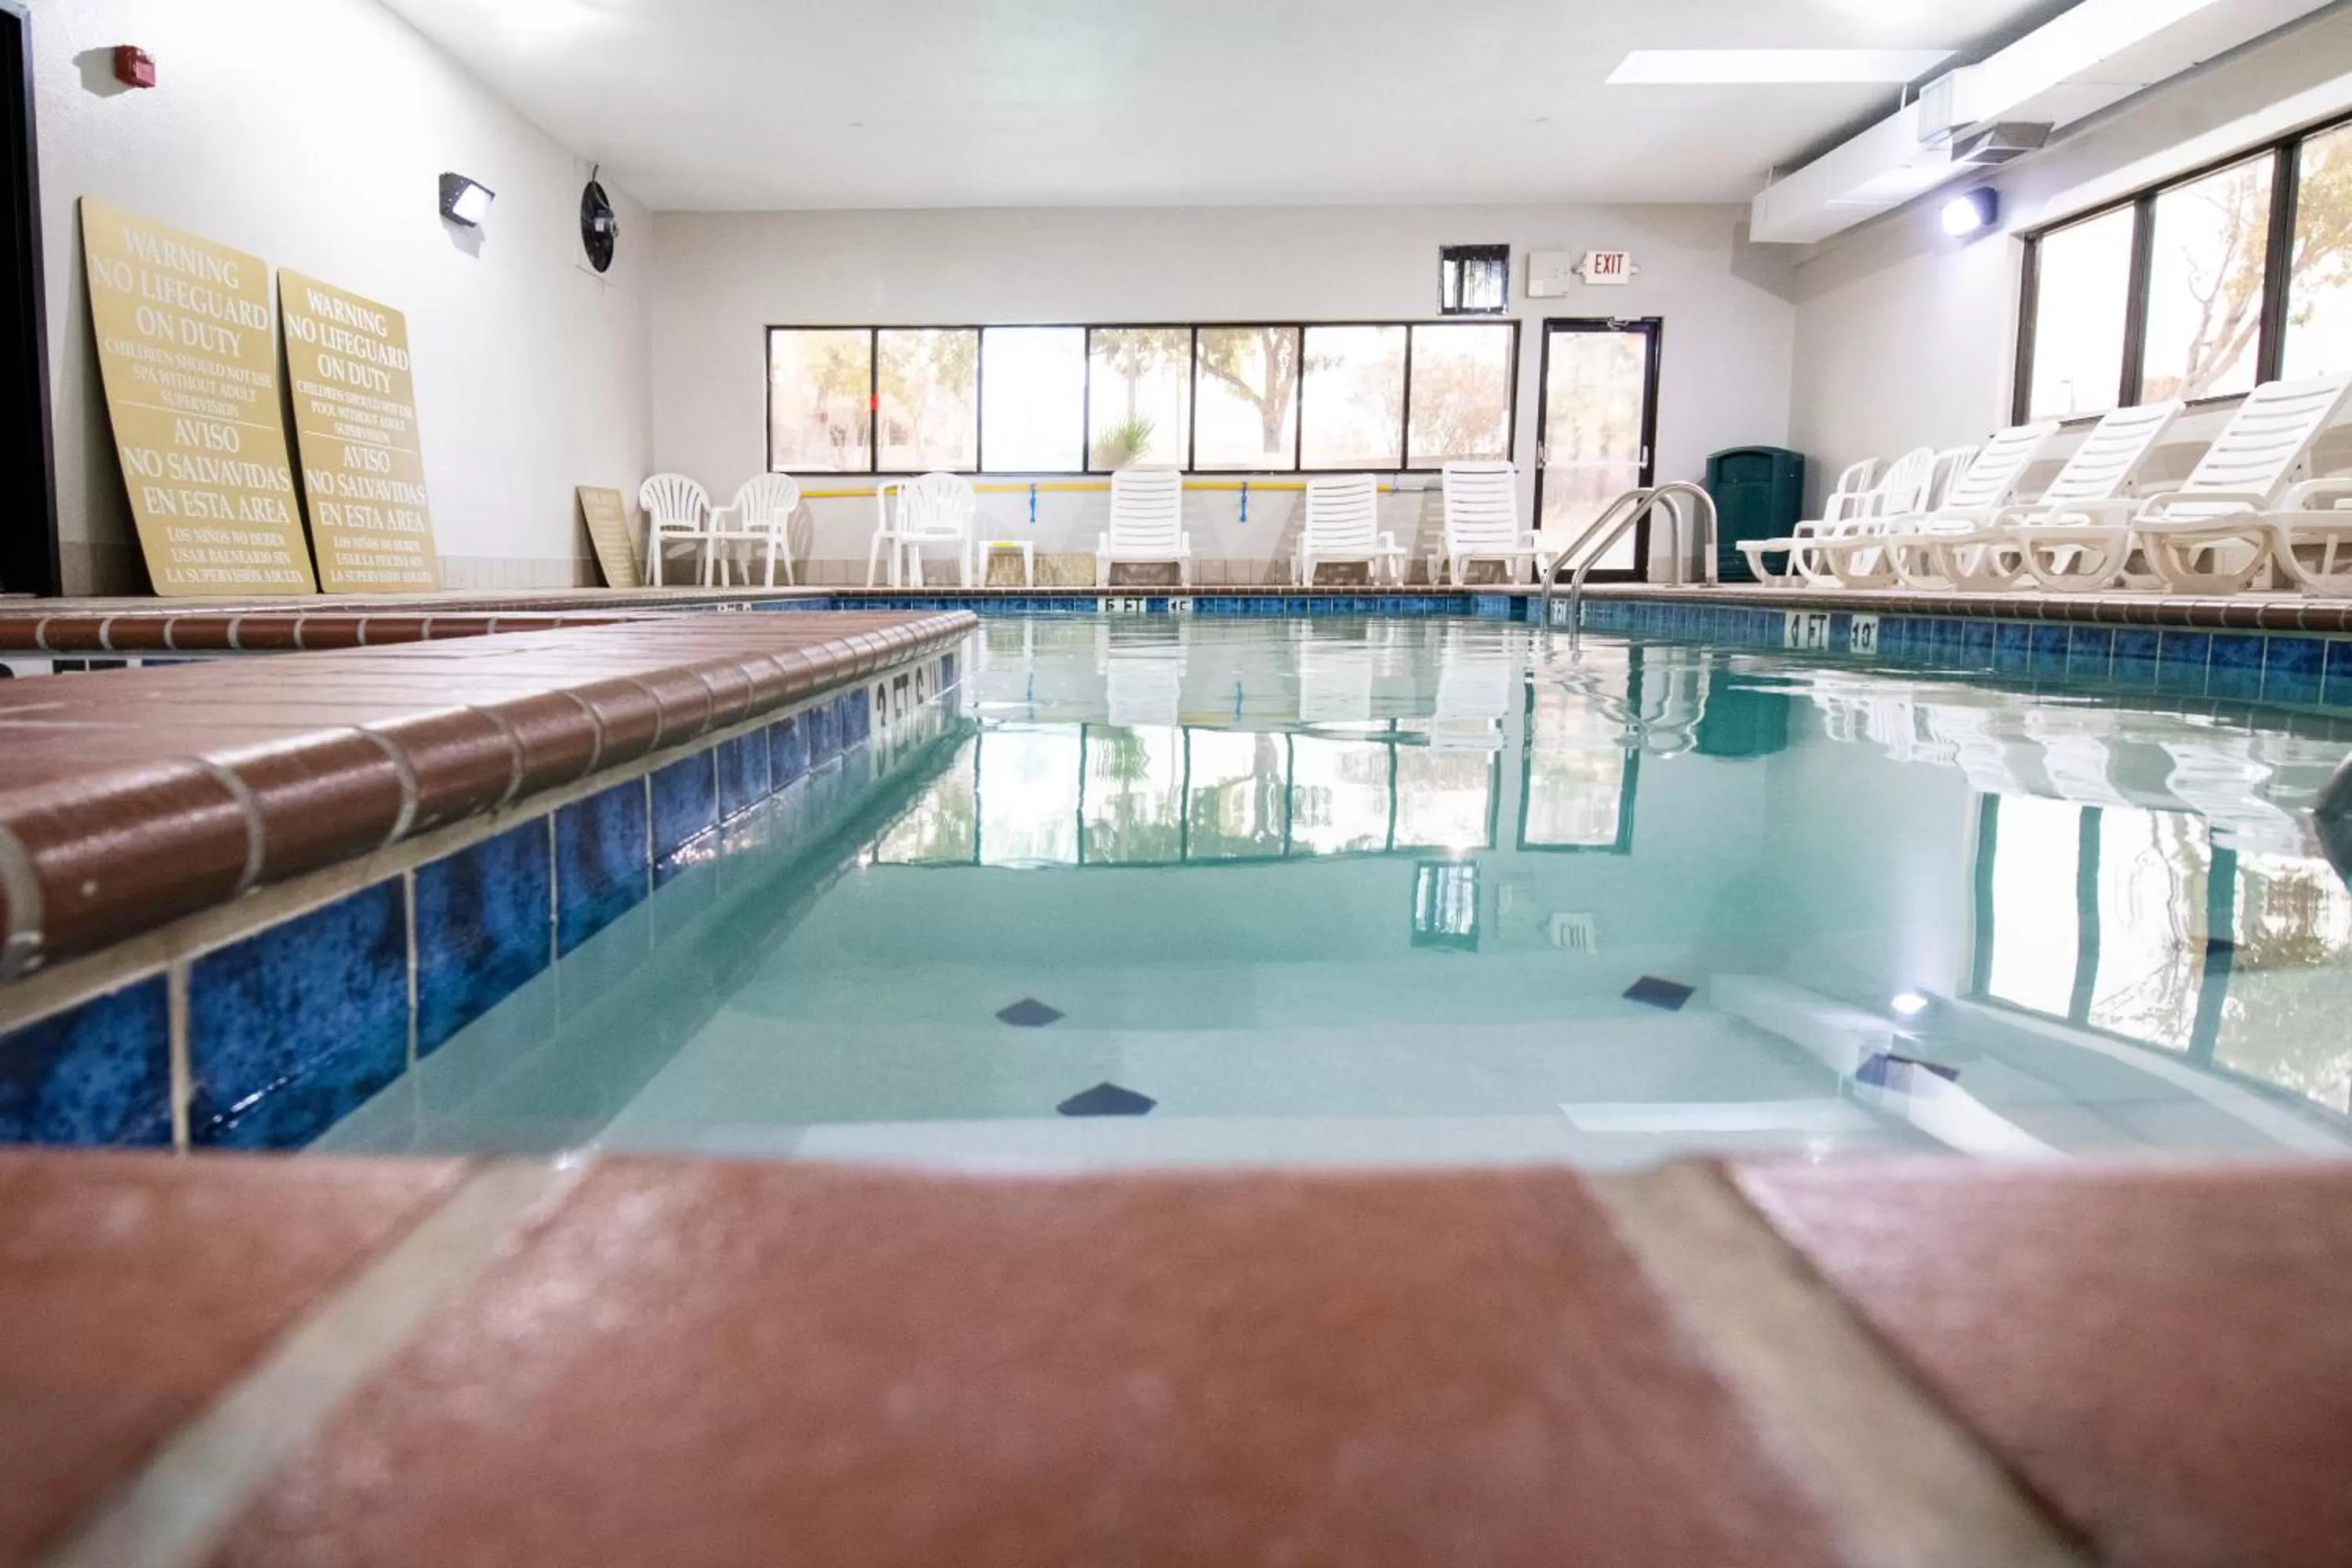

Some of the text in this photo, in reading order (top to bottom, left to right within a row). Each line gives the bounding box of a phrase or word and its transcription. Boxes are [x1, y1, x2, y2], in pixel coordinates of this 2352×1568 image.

[126, 229, 239, 289] WARNING
[1595, 253, 1624, 274] EXIT
[91, 254, 267, 331] NO LIFEGUARD
[307, 288, 388, 338] WARNING
[136, 307, 241, 358] ON DUTY
[285, 312, 409, 371] NO LIFEGUARD
[318, 354, 391, 394] ON DUTY
[175, 417, 239, 452] AVISO
[123, 446, 292, 492] NO SALVAVIDAS
[343, 445, 390, 474] AVISO
[142, 486, 290, 524] EN ESTA AREA
[307, 468, 426, 505] NO SALVAVIDAS
[167, 526, 191, 543] LOS
[318, 501, 426, 532] EN ESTA AREA
[1124, 597, 1143, 614] FT
[1807, 614, 1828, 650] FT
